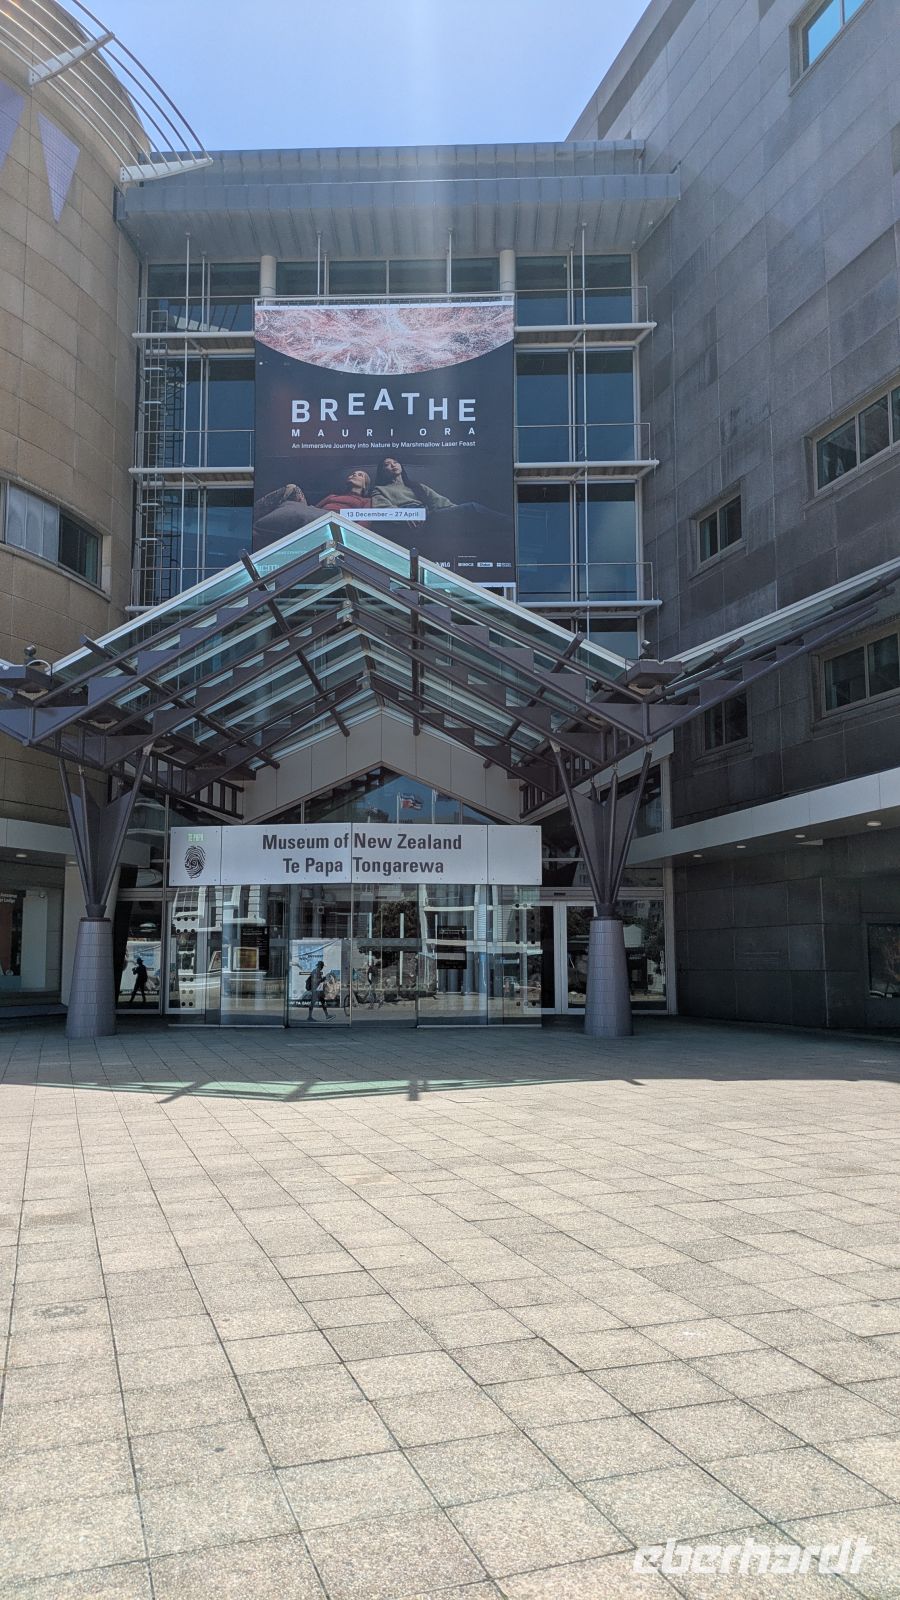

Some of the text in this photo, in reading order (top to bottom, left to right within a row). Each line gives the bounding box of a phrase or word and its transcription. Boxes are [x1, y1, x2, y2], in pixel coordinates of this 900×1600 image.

[291, 388, 476, 423] BREATHE
[291, 427, 476, 437] MAURI ORA
[262, 832, 462, 850] Museum of New Zealand
[282, 857, 444, 877] Te Papa Tongarewa
